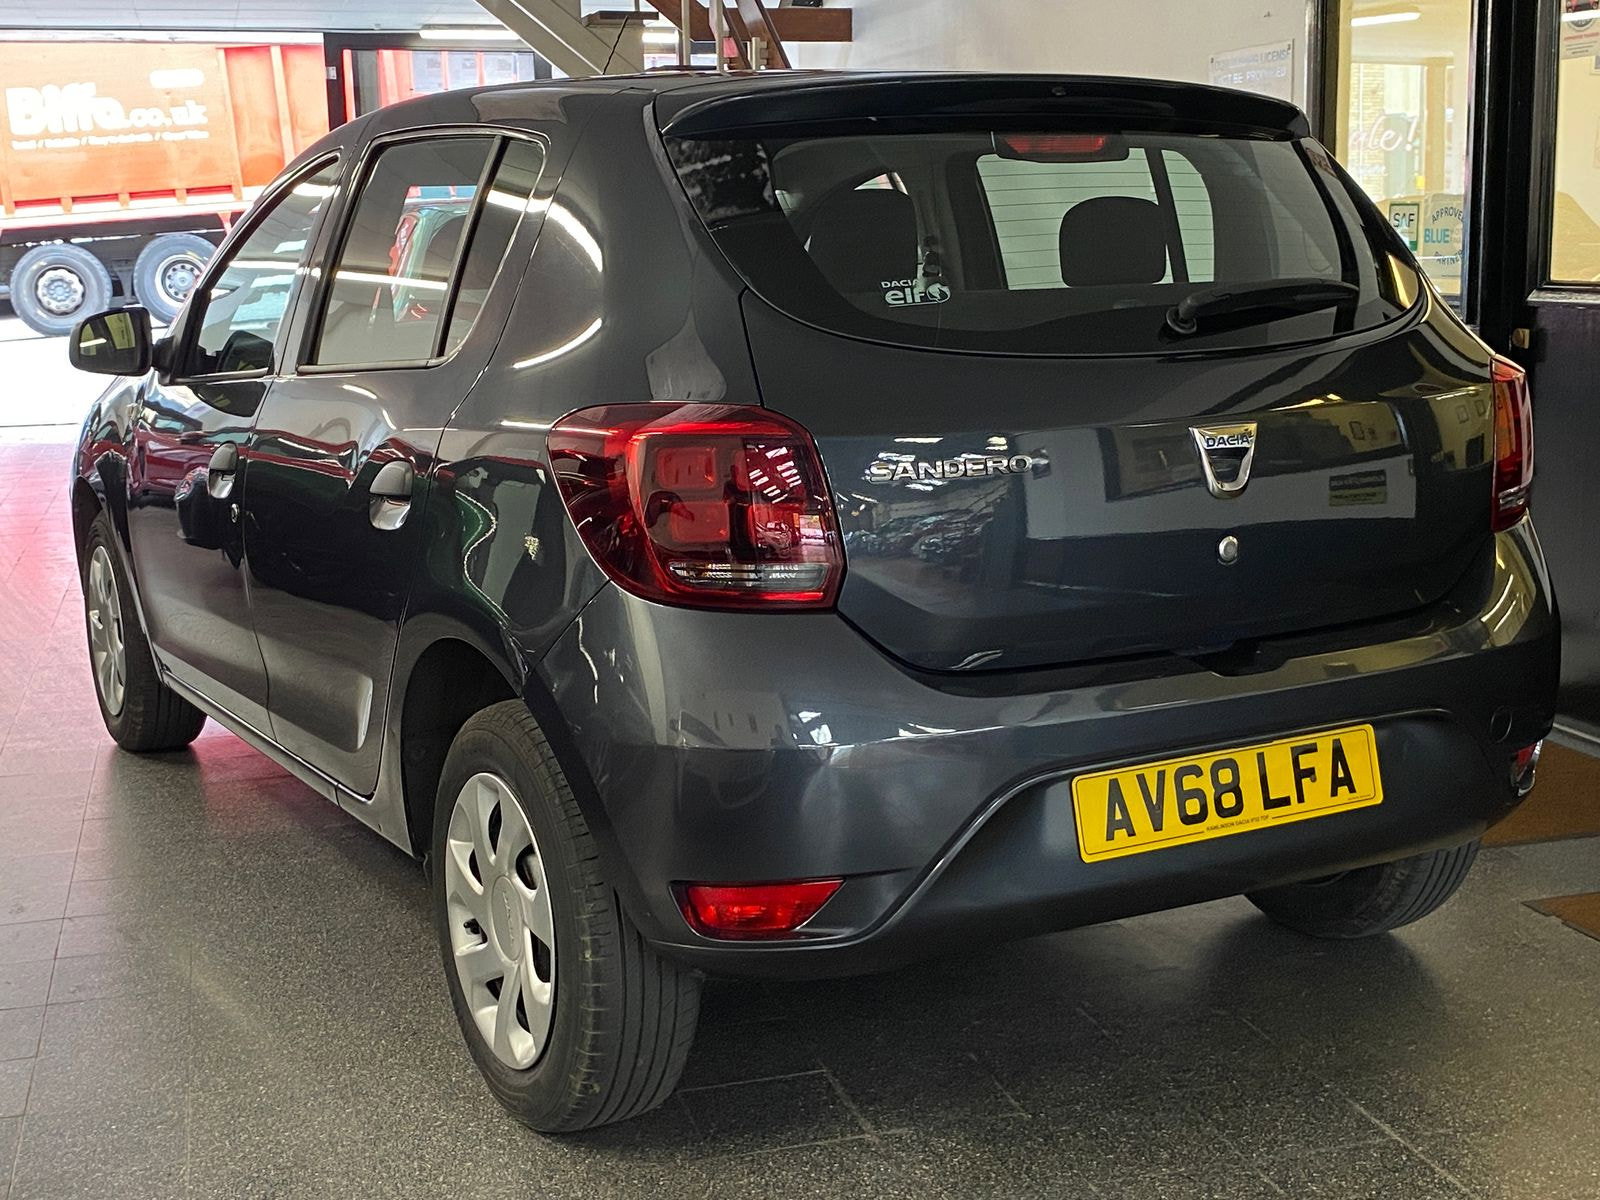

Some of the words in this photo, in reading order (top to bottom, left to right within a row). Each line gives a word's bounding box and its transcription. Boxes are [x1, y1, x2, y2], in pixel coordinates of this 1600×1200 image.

[1424, 228, 1450, 243] BLUE
[1206, 434, 1250, 448] DACIA
[870, 455, 1033, 482] SANDERO
[1105, 757, 1244, 842] AV68
[1256, 738, 1357, 811] LFA
